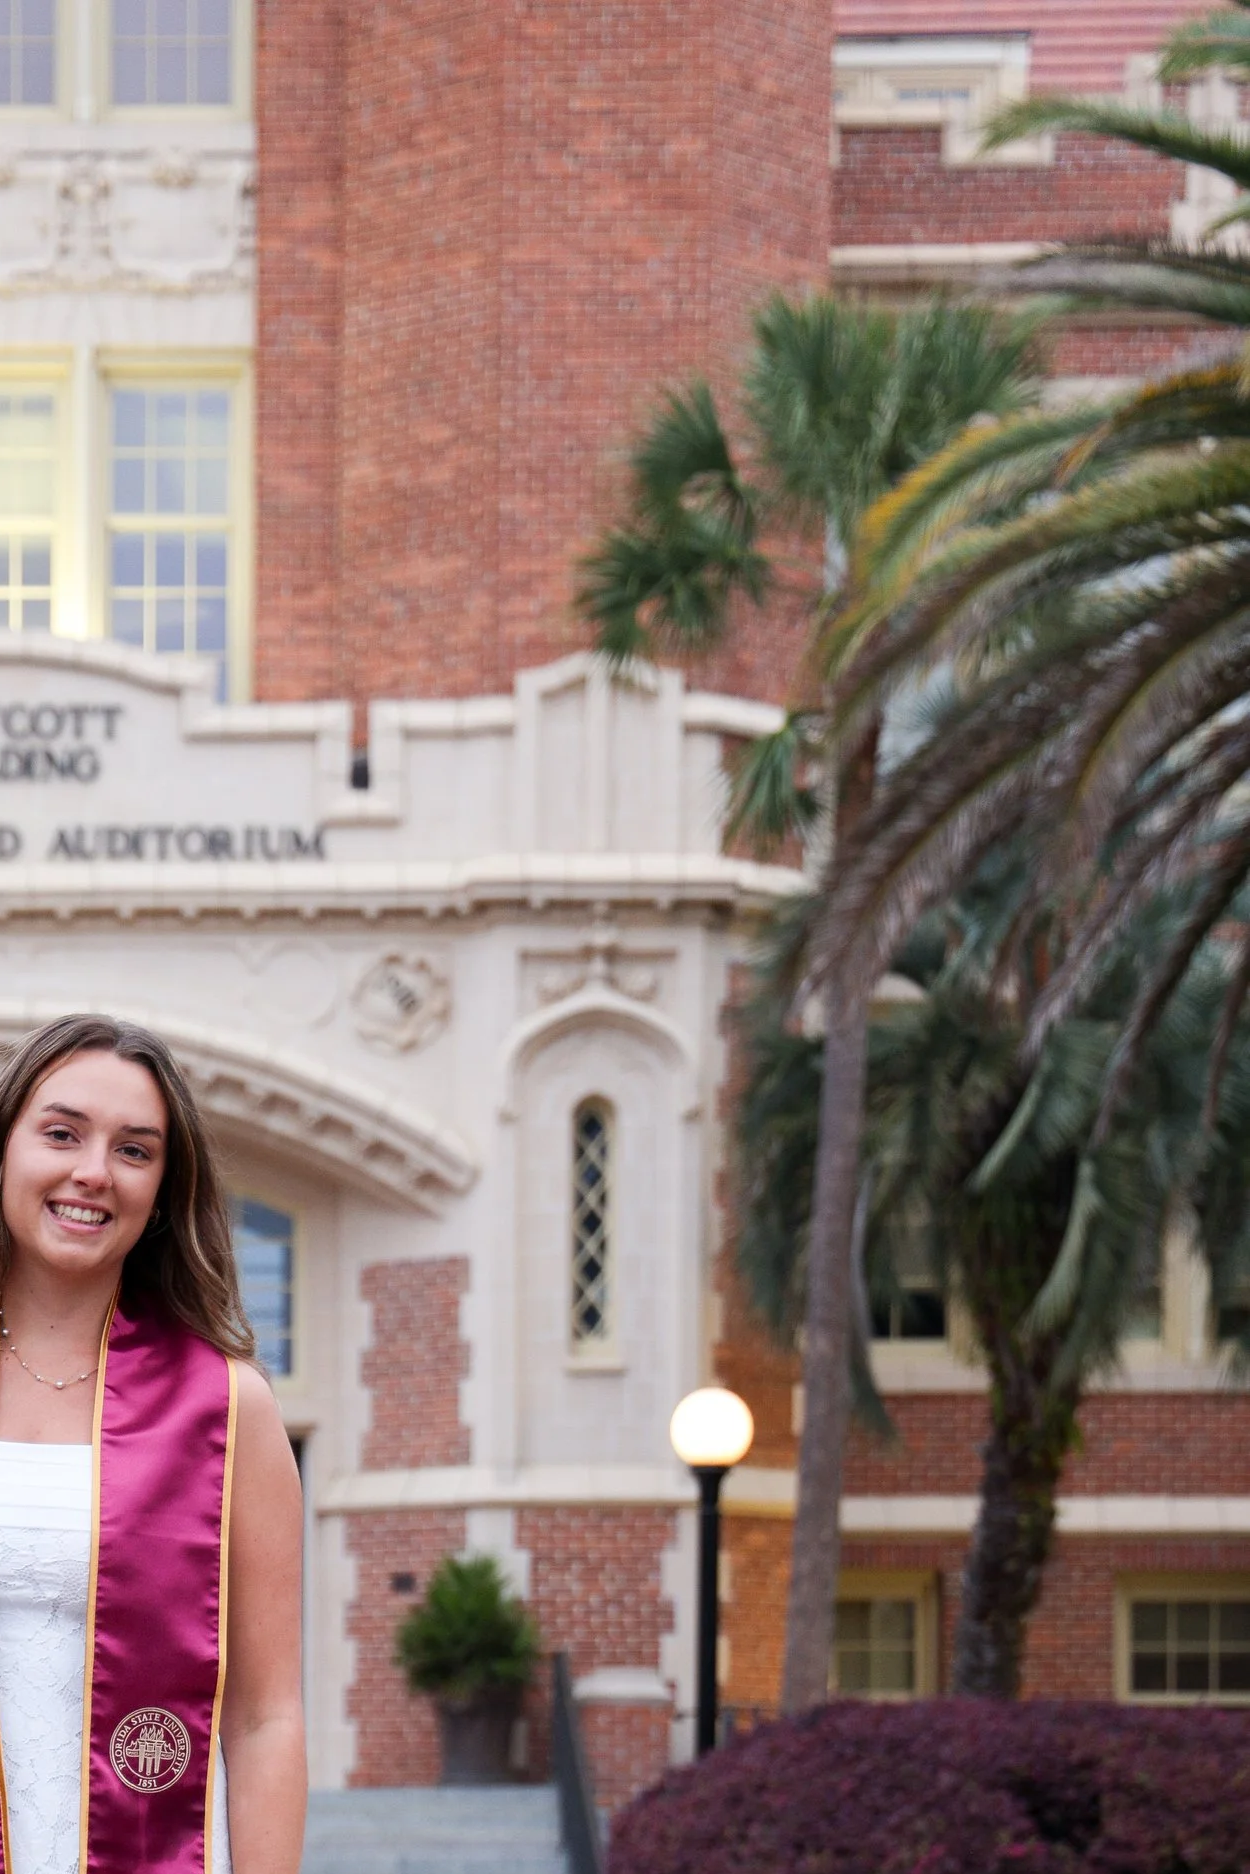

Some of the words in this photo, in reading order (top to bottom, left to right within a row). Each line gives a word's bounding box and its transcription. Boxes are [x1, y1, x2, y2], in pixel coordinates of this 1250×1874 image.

[50, 824, 326, 862] AUDITORIUM
[130, 1712, 161, 1726] STATE
[162, 1718, 185, 1775] UNIVERSITY
[137, 1778, 157, 1788] 1851
